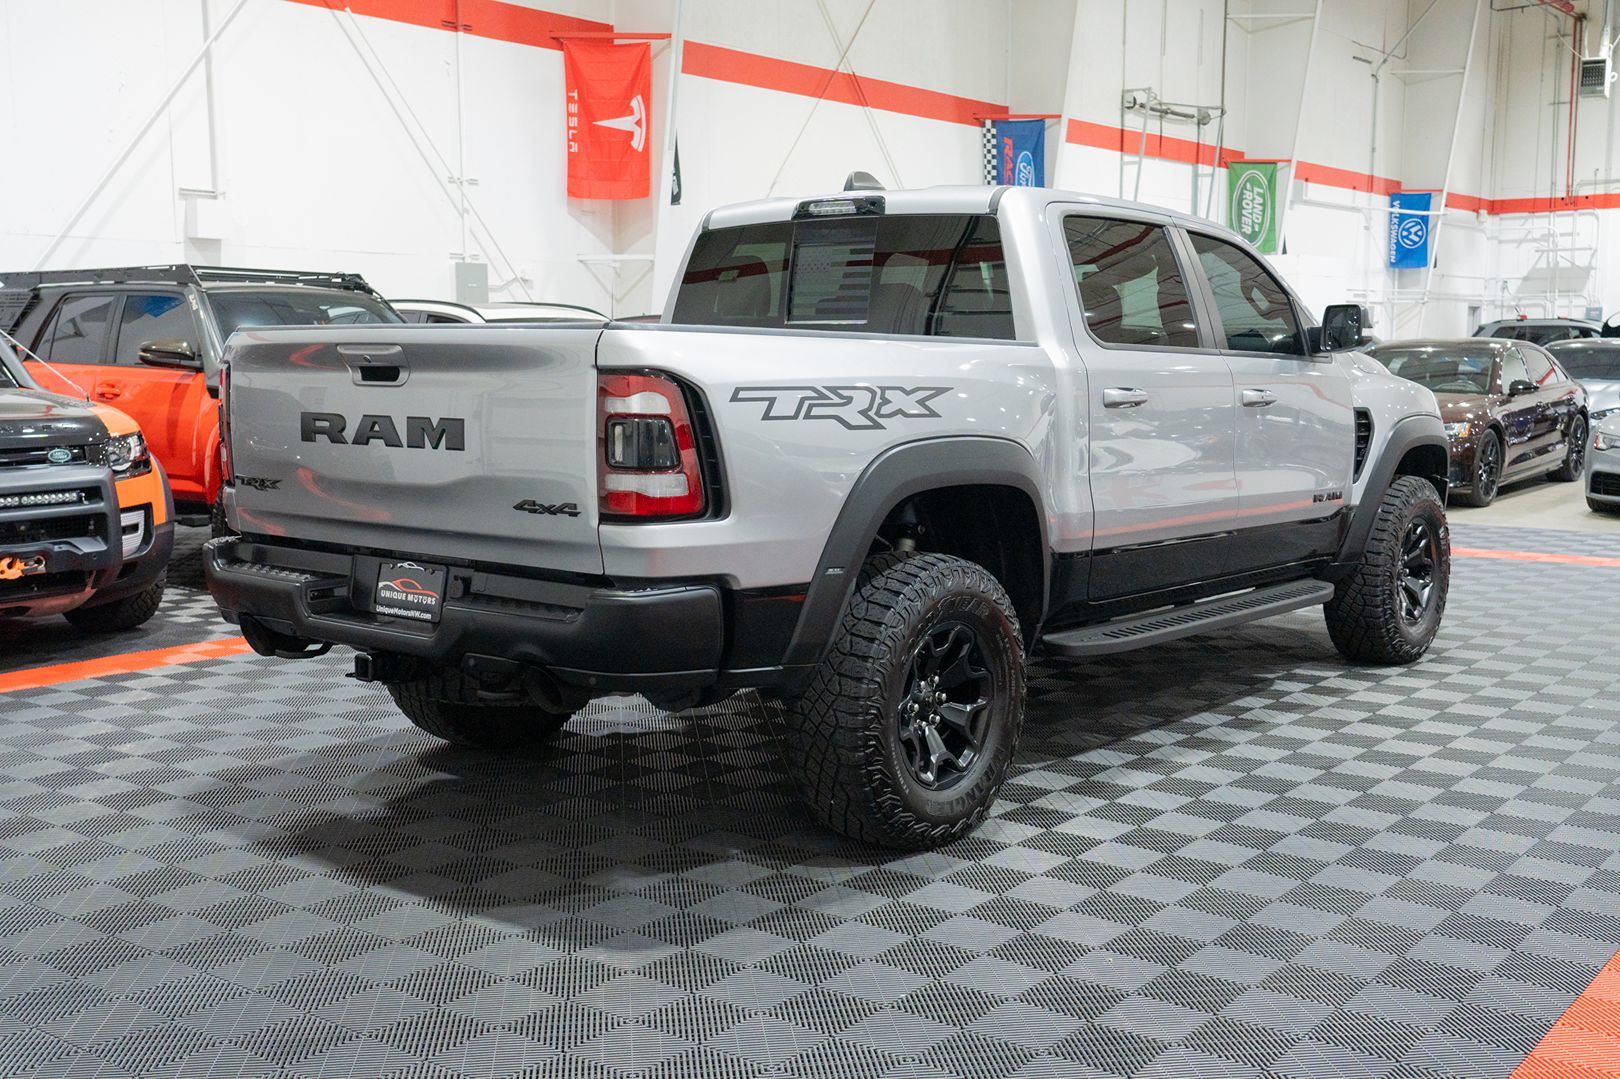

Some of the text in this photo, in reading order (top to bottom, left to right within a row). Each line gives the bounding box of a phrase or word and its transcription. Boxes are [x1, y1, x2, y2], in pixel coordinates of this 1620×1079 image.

[568, 89, 578, 152] TESLA
[729, 386, 955, 431] TRX
[301, 412, 465, 451] RAM
[1313, 491, 1343, 503] RAM
[512, 499, 581, 517] 4x4
[380, 590, 436, 606] UNIQUE MOTORS
[376, 604, 432, 620] UniqueMotorsNW.com
